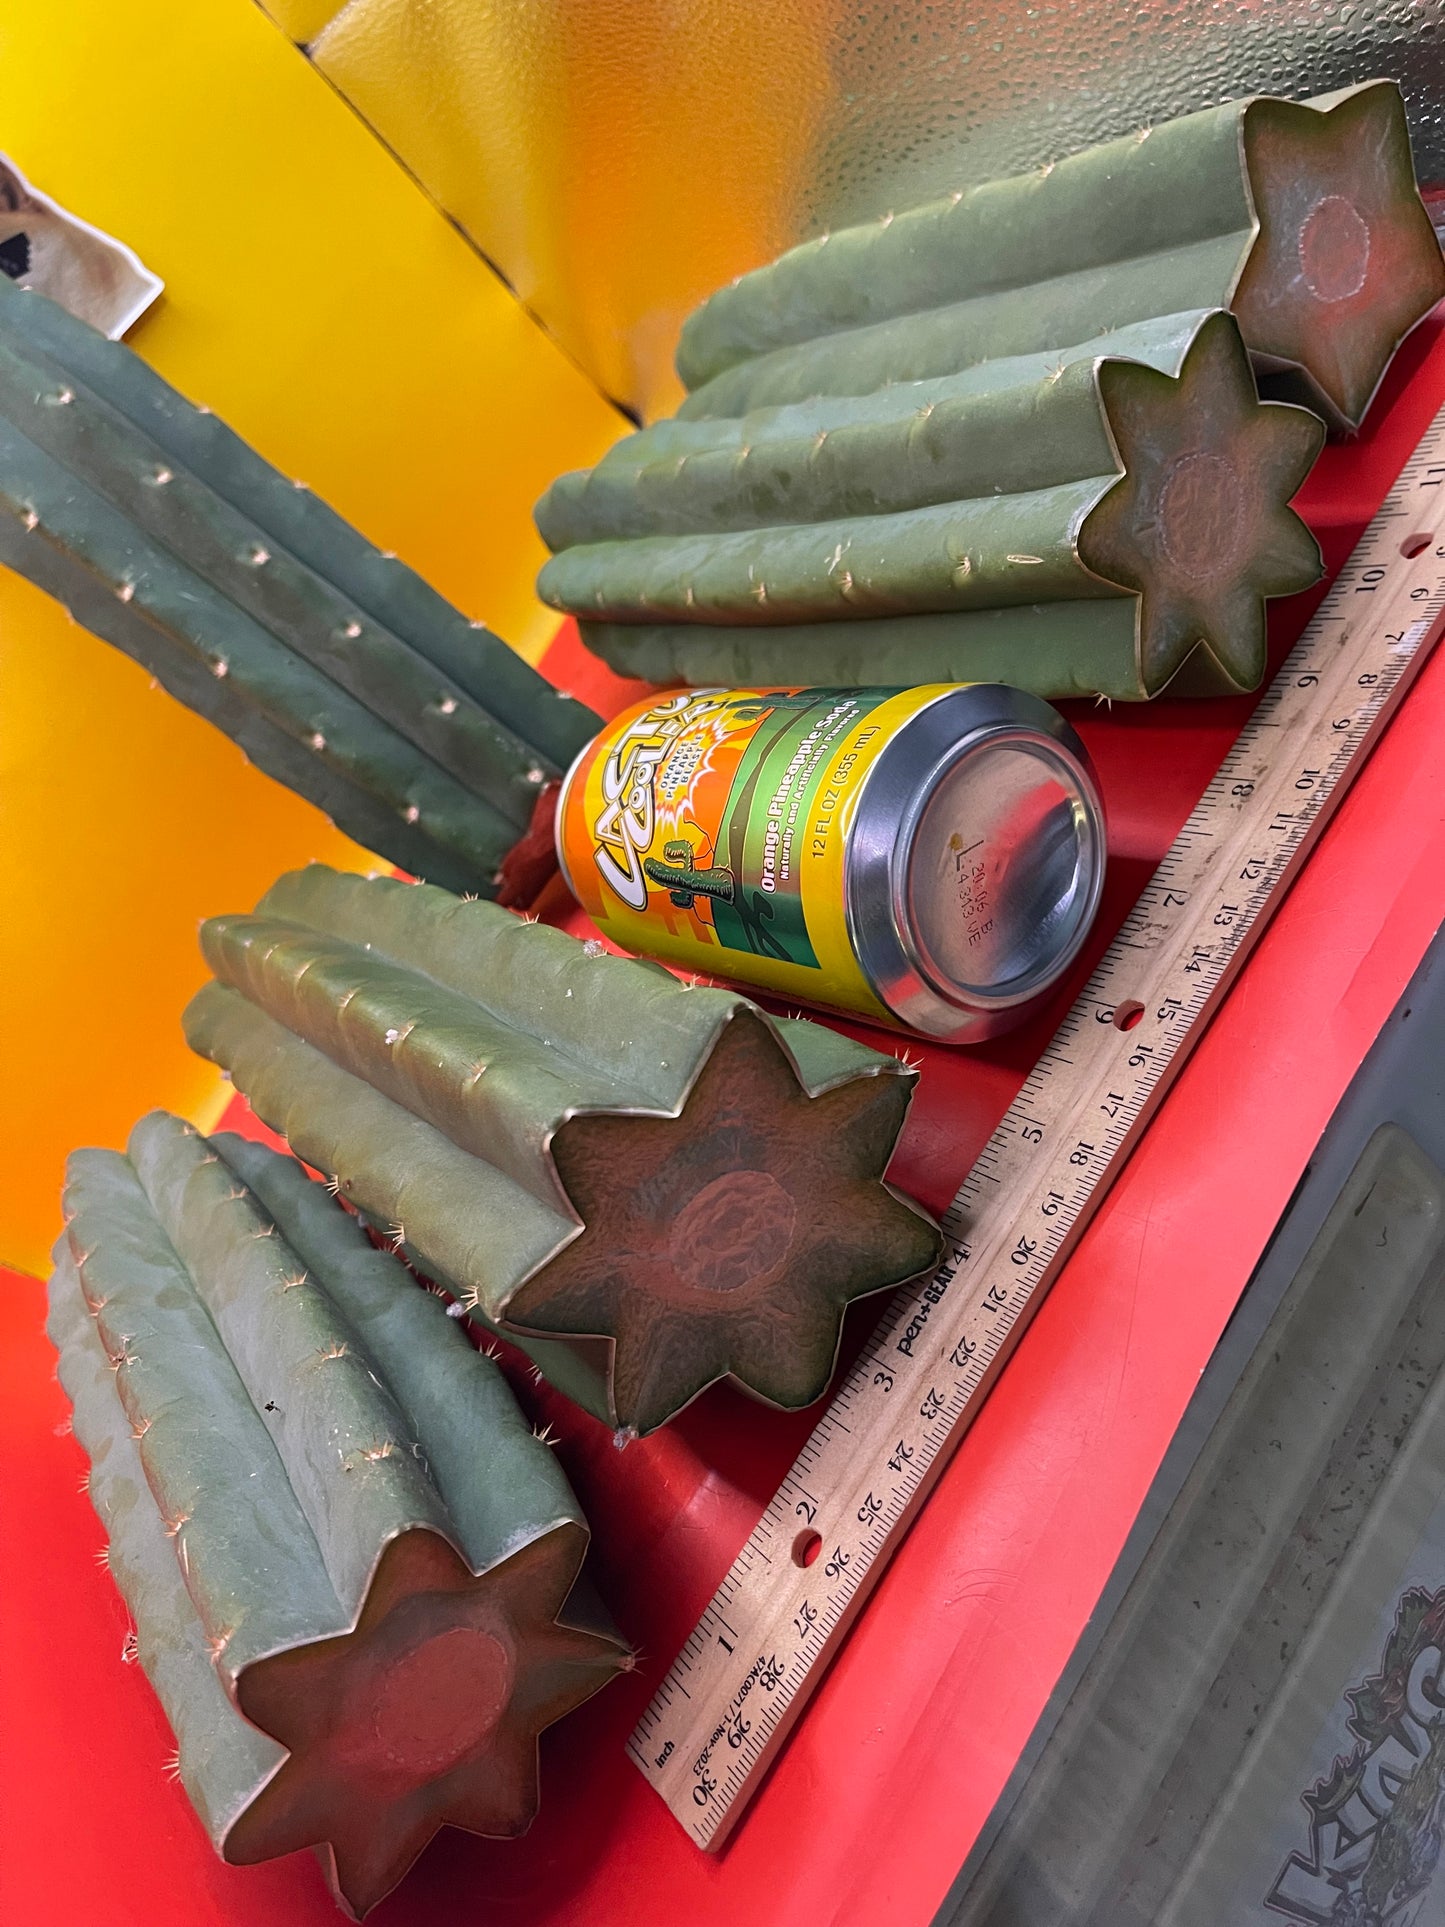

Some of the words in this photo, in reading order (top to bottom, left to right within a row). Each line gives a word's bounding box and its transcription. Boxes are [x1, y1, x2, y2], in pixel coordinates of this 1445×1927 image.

[1419, 468, 1445, 488] 11
[1356, 569, 1386, 594] 10
[1385, 631, 1405, 646] 7
[1297, 675, 1319, 688] 9
[1358, 673, 1378, 686] 8
[815, 700, 858, 730] Soda
[1332, 718, 1351, 731] 9
[853, 725, 881, 750] mL)
[660, 742, 689, 789] ORANGE
[666, 735, 703, 799] PINEAPPLE
[680, 748, 704, 783] BLAST
[767, 726, 821, 817] Pineapple
[793, 743, 830, 801] Artificially
[831, 753, 858, 785] (355
[1231, 784, 1255, 797] 8
[1295, 768, 1321, 790] 10
[823, 789, 840, 810] OZ
[787, 802, 799, 825] and
[815, 815, 832, 836] FL
[1269, 811, 1295, 831] 11
[761, 820, 780, 894] Orange
[780, 827, 795, 880] Naturally
[812, 838, 826, 858] 12
[1239, 857, 1266, 880] 12
[1163, 893, 1186, 908] 7
[1213, 902, 1239, 926] 13
[1184, 949, 1210, 973] 14
[1157, 997, 1182, 1021] 15
[1128, 1044, 1153, 1068] 16
[1100, 1092, 1125, 1119] 17
[1021, 1125, 1043, 1144] 5
[1069, 1140, 1094, 1166] 18
[1041, 1190, 1065, 1217] 19
[952, 1247, 971, 1266] 4
[1010, 1235, 1037, 1266] 20
[980, 1284, 1008, 1314] 21
[949, 1336, 976, 1367] 22
[874, 1371, 894, 1392] 3
[920, 1387, 945, 1420] 23
[887, 1440, 914, 1473] 24
[796, 1500, 816, 1524] 2
[857, 1492, 883, 1526] 25
[825, 1545, 850, 1579] 26
[792, 1599, 818, 1639] 27
[716, 1635, 735, 1656] 1
[732, 1655, 766, 1708] 47AC0071
[759, 1654, 786, 1692] 28
[727, 1711, 751, 1749] 29
[655, 1739, 675, 1769] inch
[693, 1768, 717, 1806] 30
